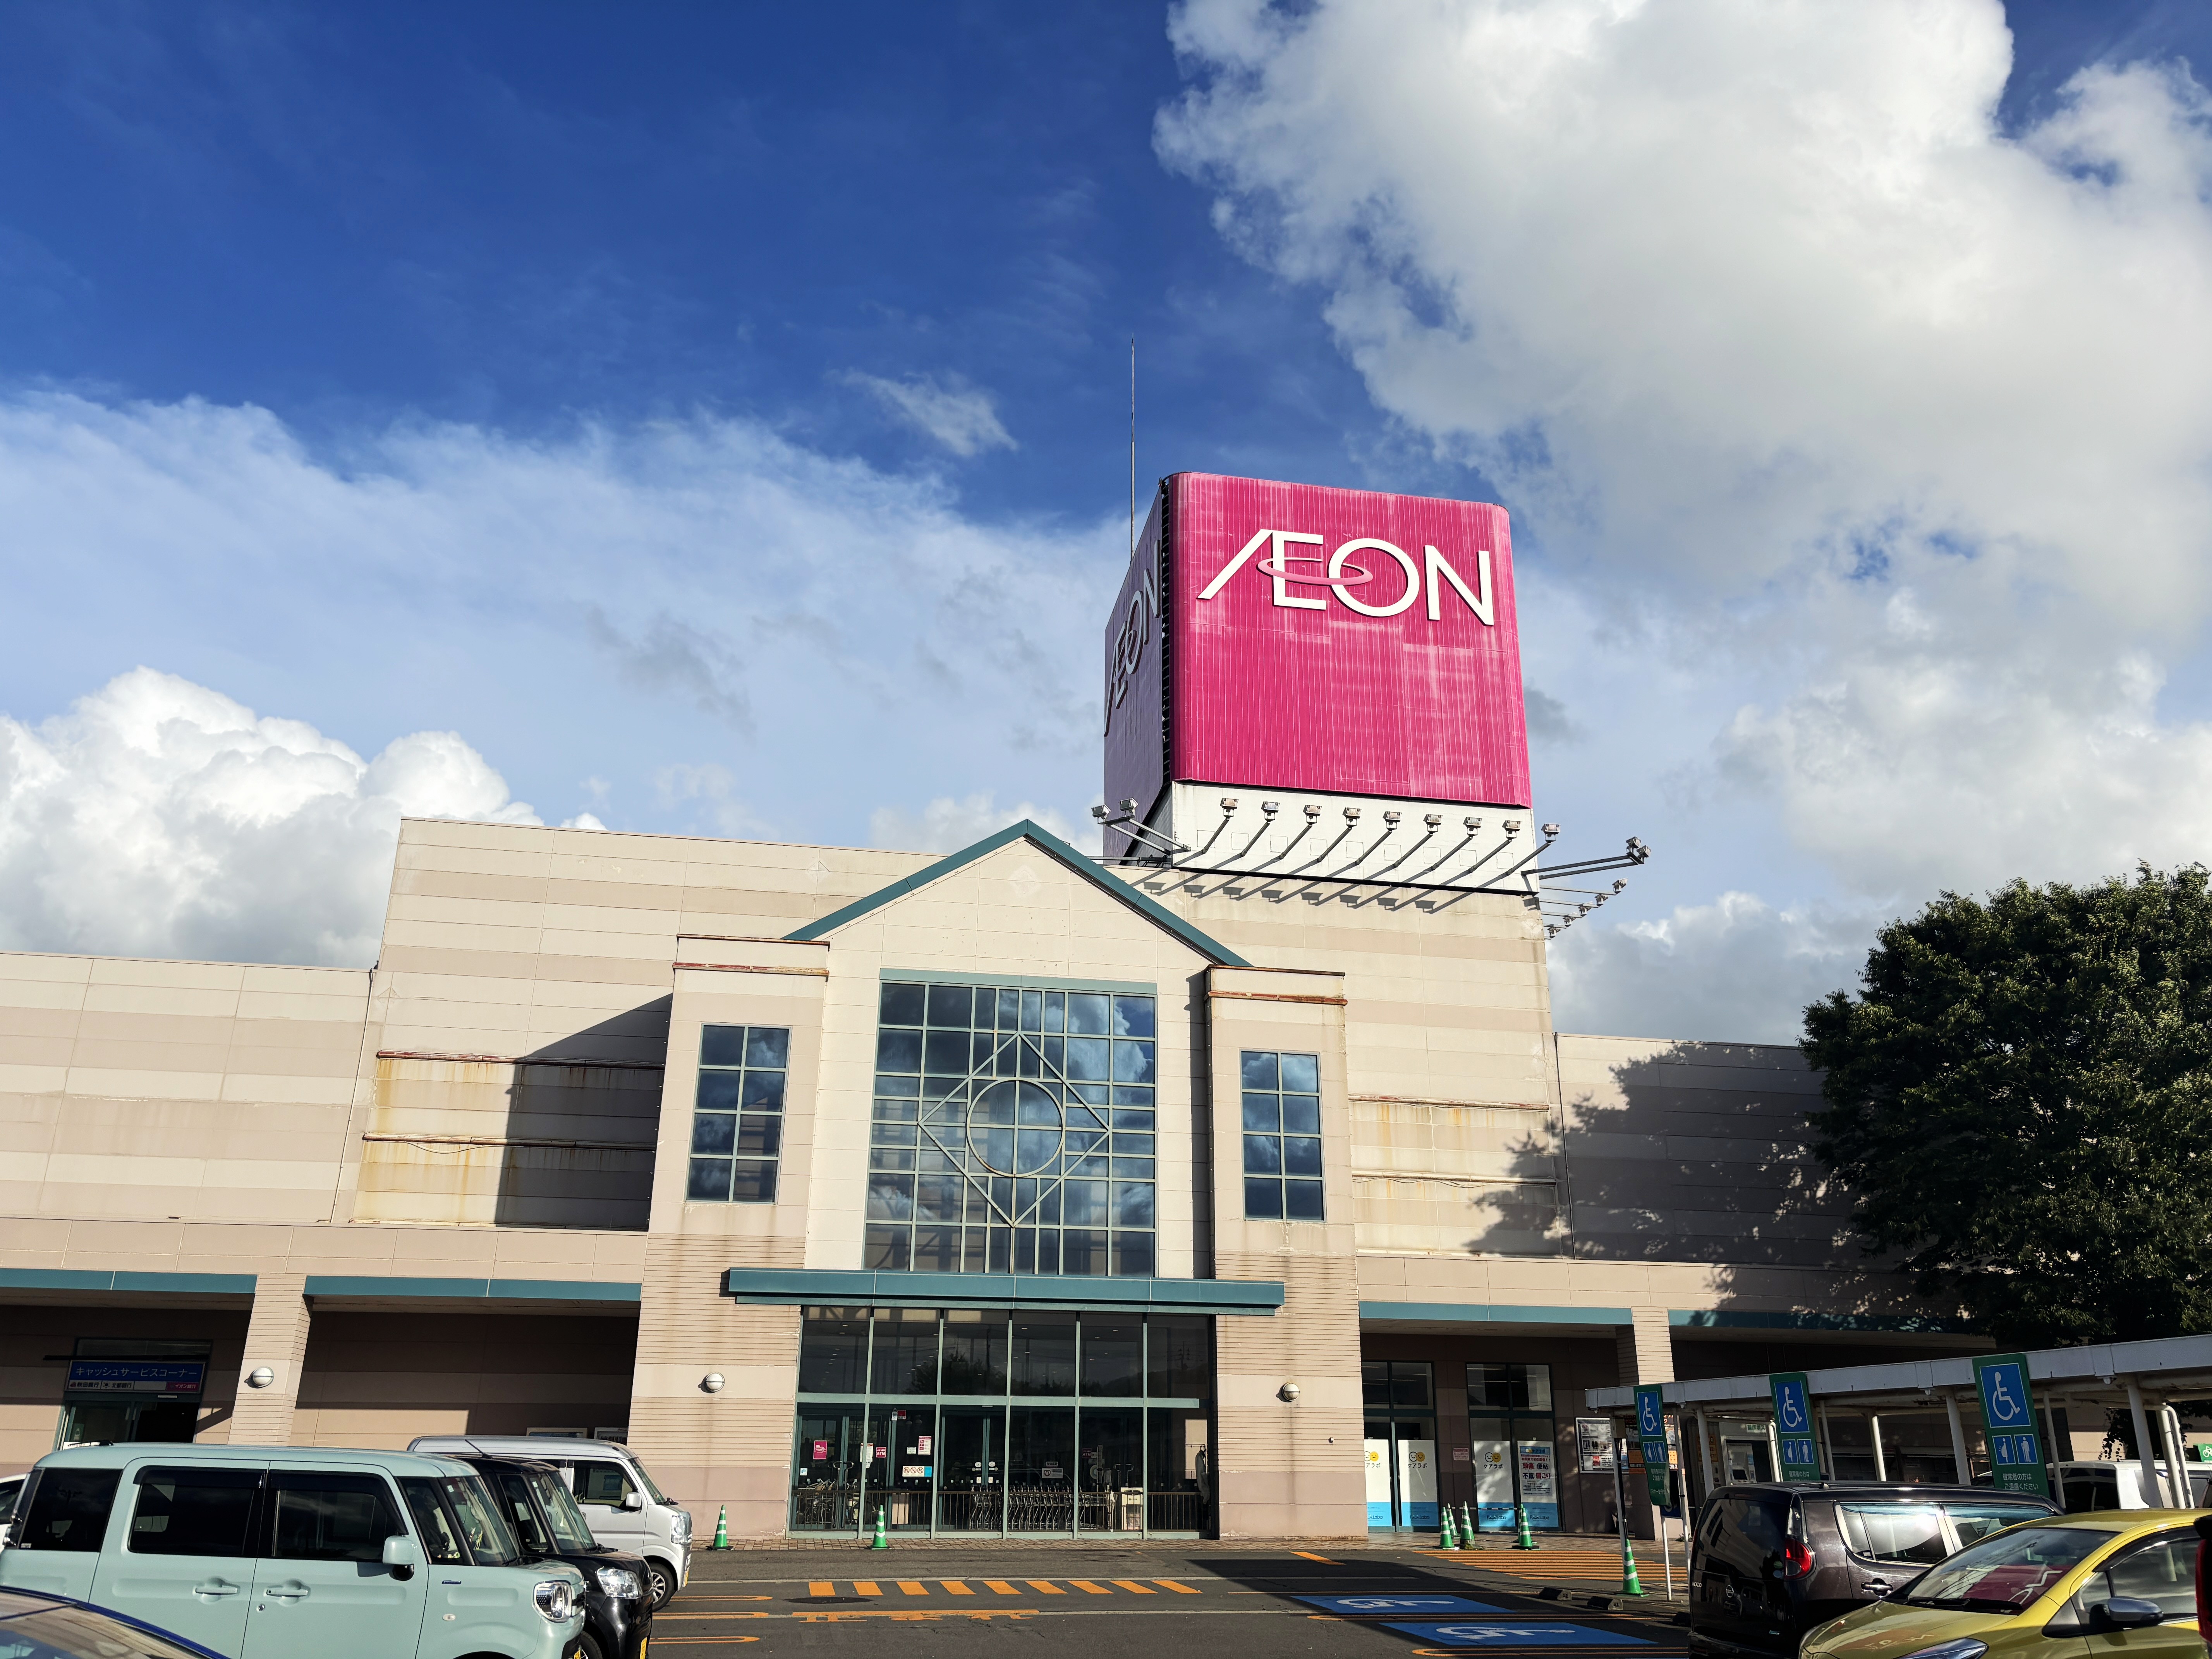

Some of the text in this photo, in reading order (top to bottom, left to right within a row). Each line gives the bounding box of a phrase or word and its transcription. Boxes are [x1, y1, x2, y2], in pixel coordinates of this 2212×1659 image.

[76, 1367, 197, 1378] キャッシュサービスコーナー
